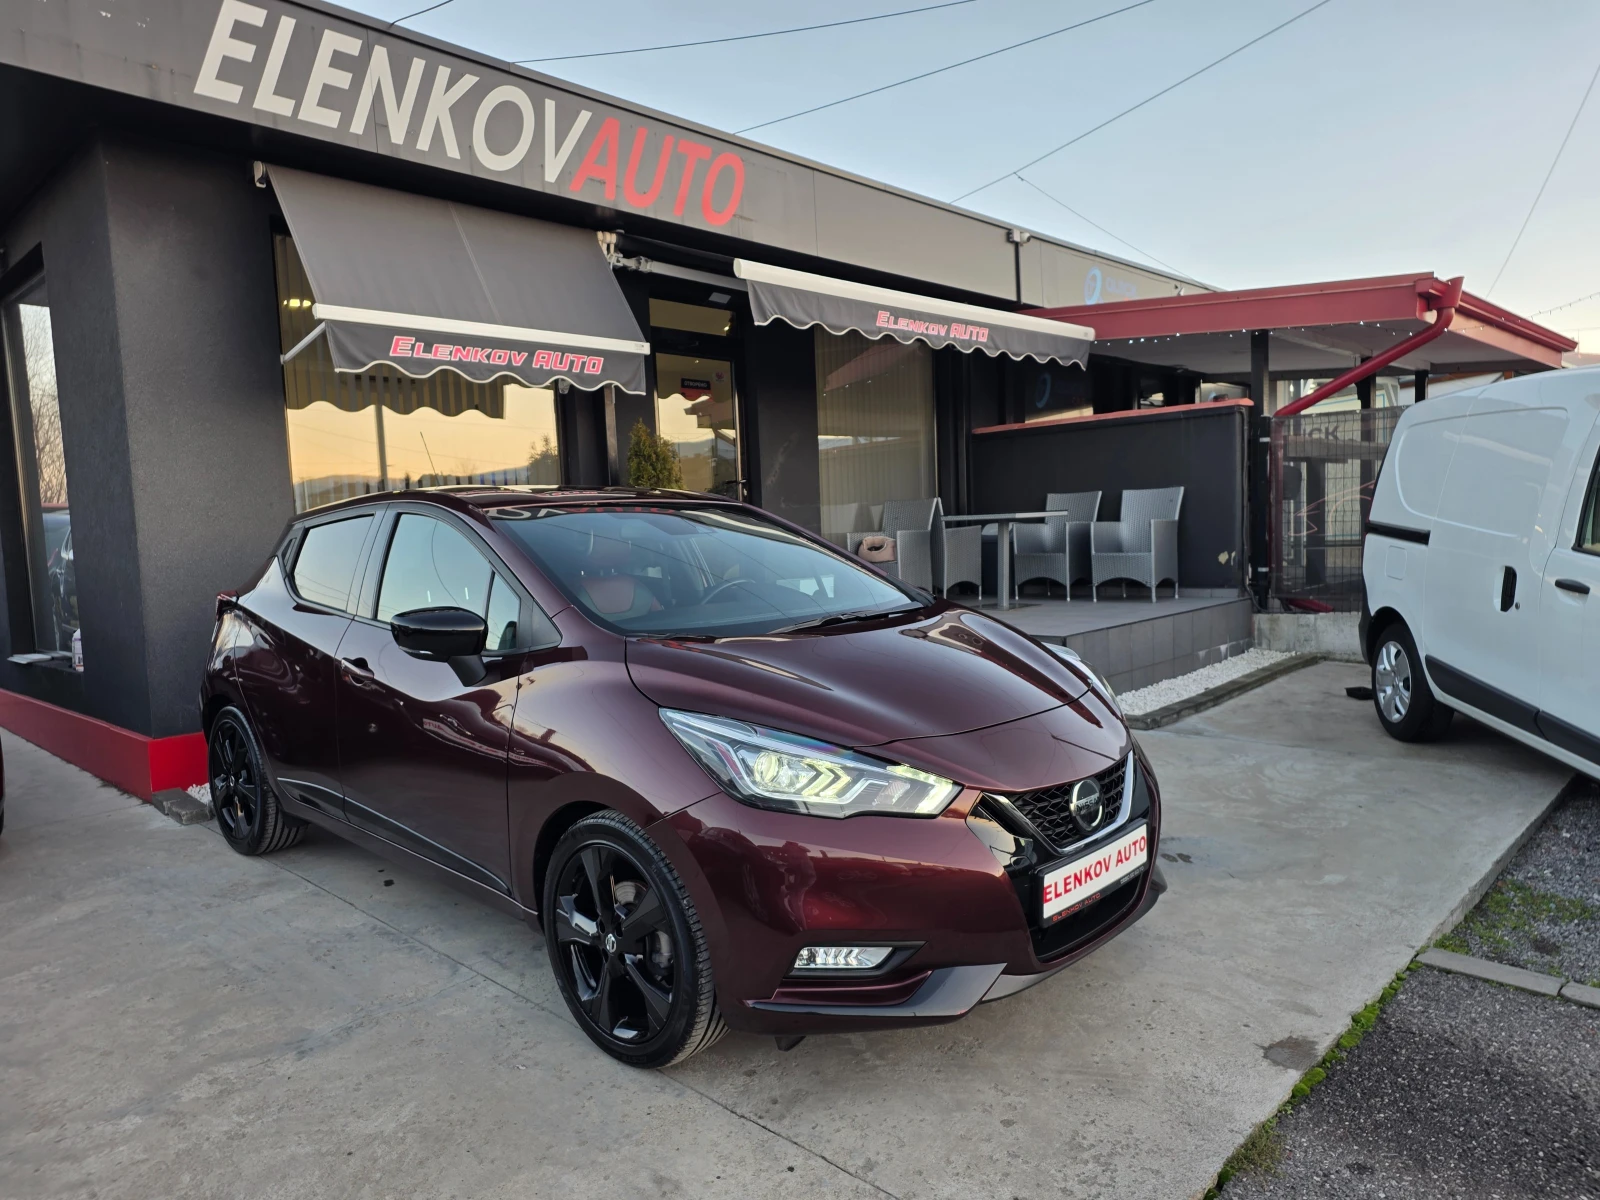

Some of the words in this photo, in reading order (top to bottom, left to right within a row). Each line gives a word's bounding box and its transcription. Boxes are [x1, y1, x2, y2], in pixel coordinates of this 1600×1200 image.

[949, 323, 989, 342] AUTO
[532, 350, 604, 374] AUTO
[1043, 854, 1112, 903] ELENKOV
[1115, 835, 1147, 867] AUTO
[1084, 892, 1101, 906] AUTO
